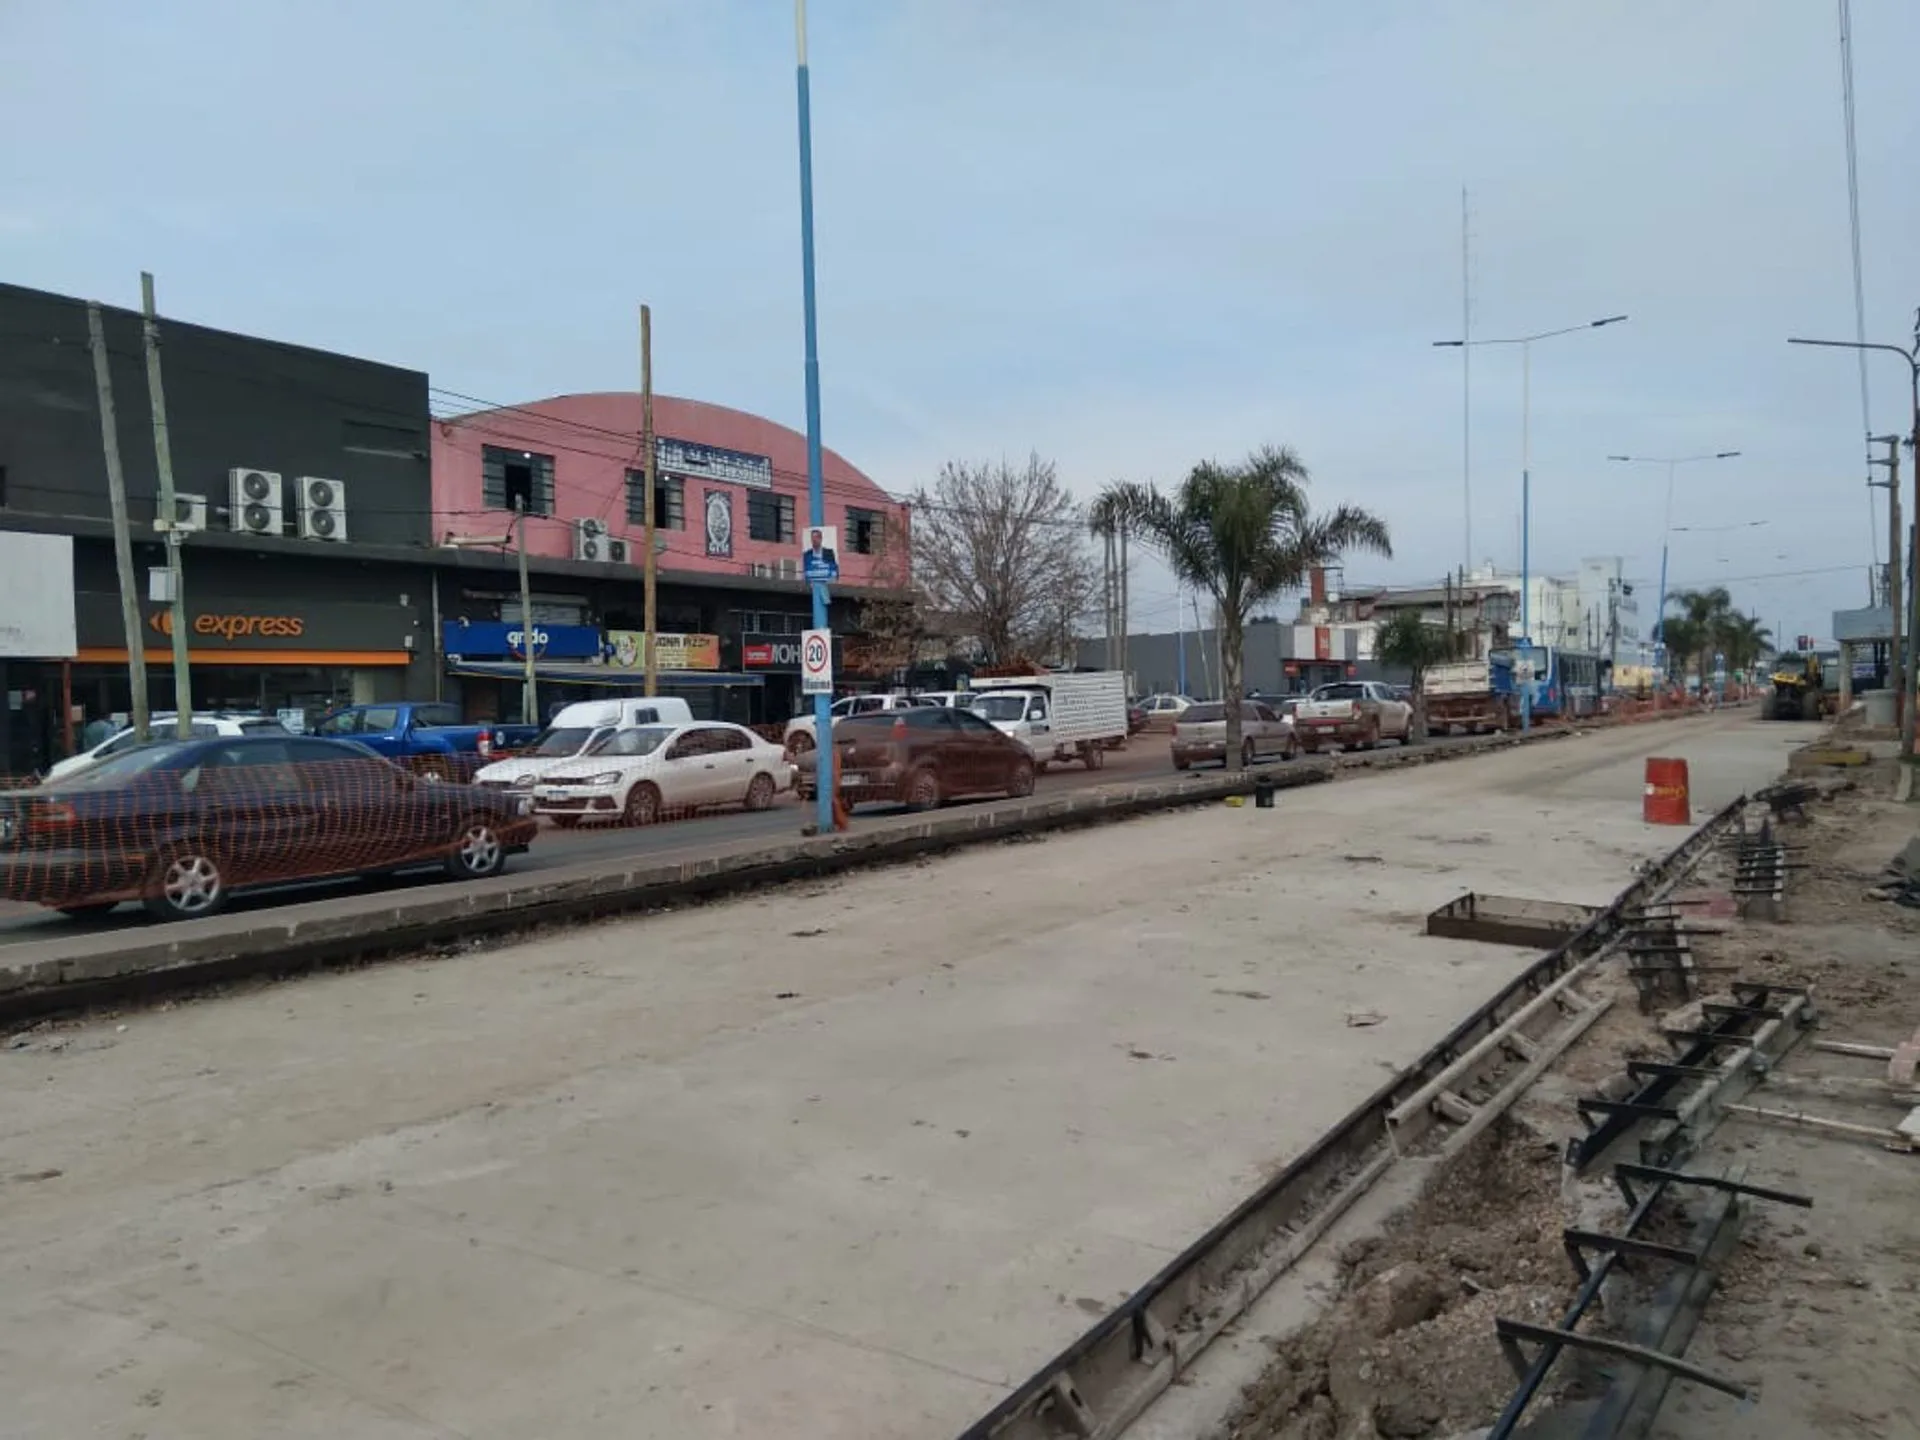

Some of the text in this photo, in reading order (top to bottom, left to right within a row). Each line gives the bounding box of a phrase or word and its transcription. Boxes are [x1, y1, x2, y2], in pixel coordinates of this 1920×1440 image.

[194, 613, 305, 641] express
[506, 627, 549, 649] grdo
[808, 644, 824, 662] 20
